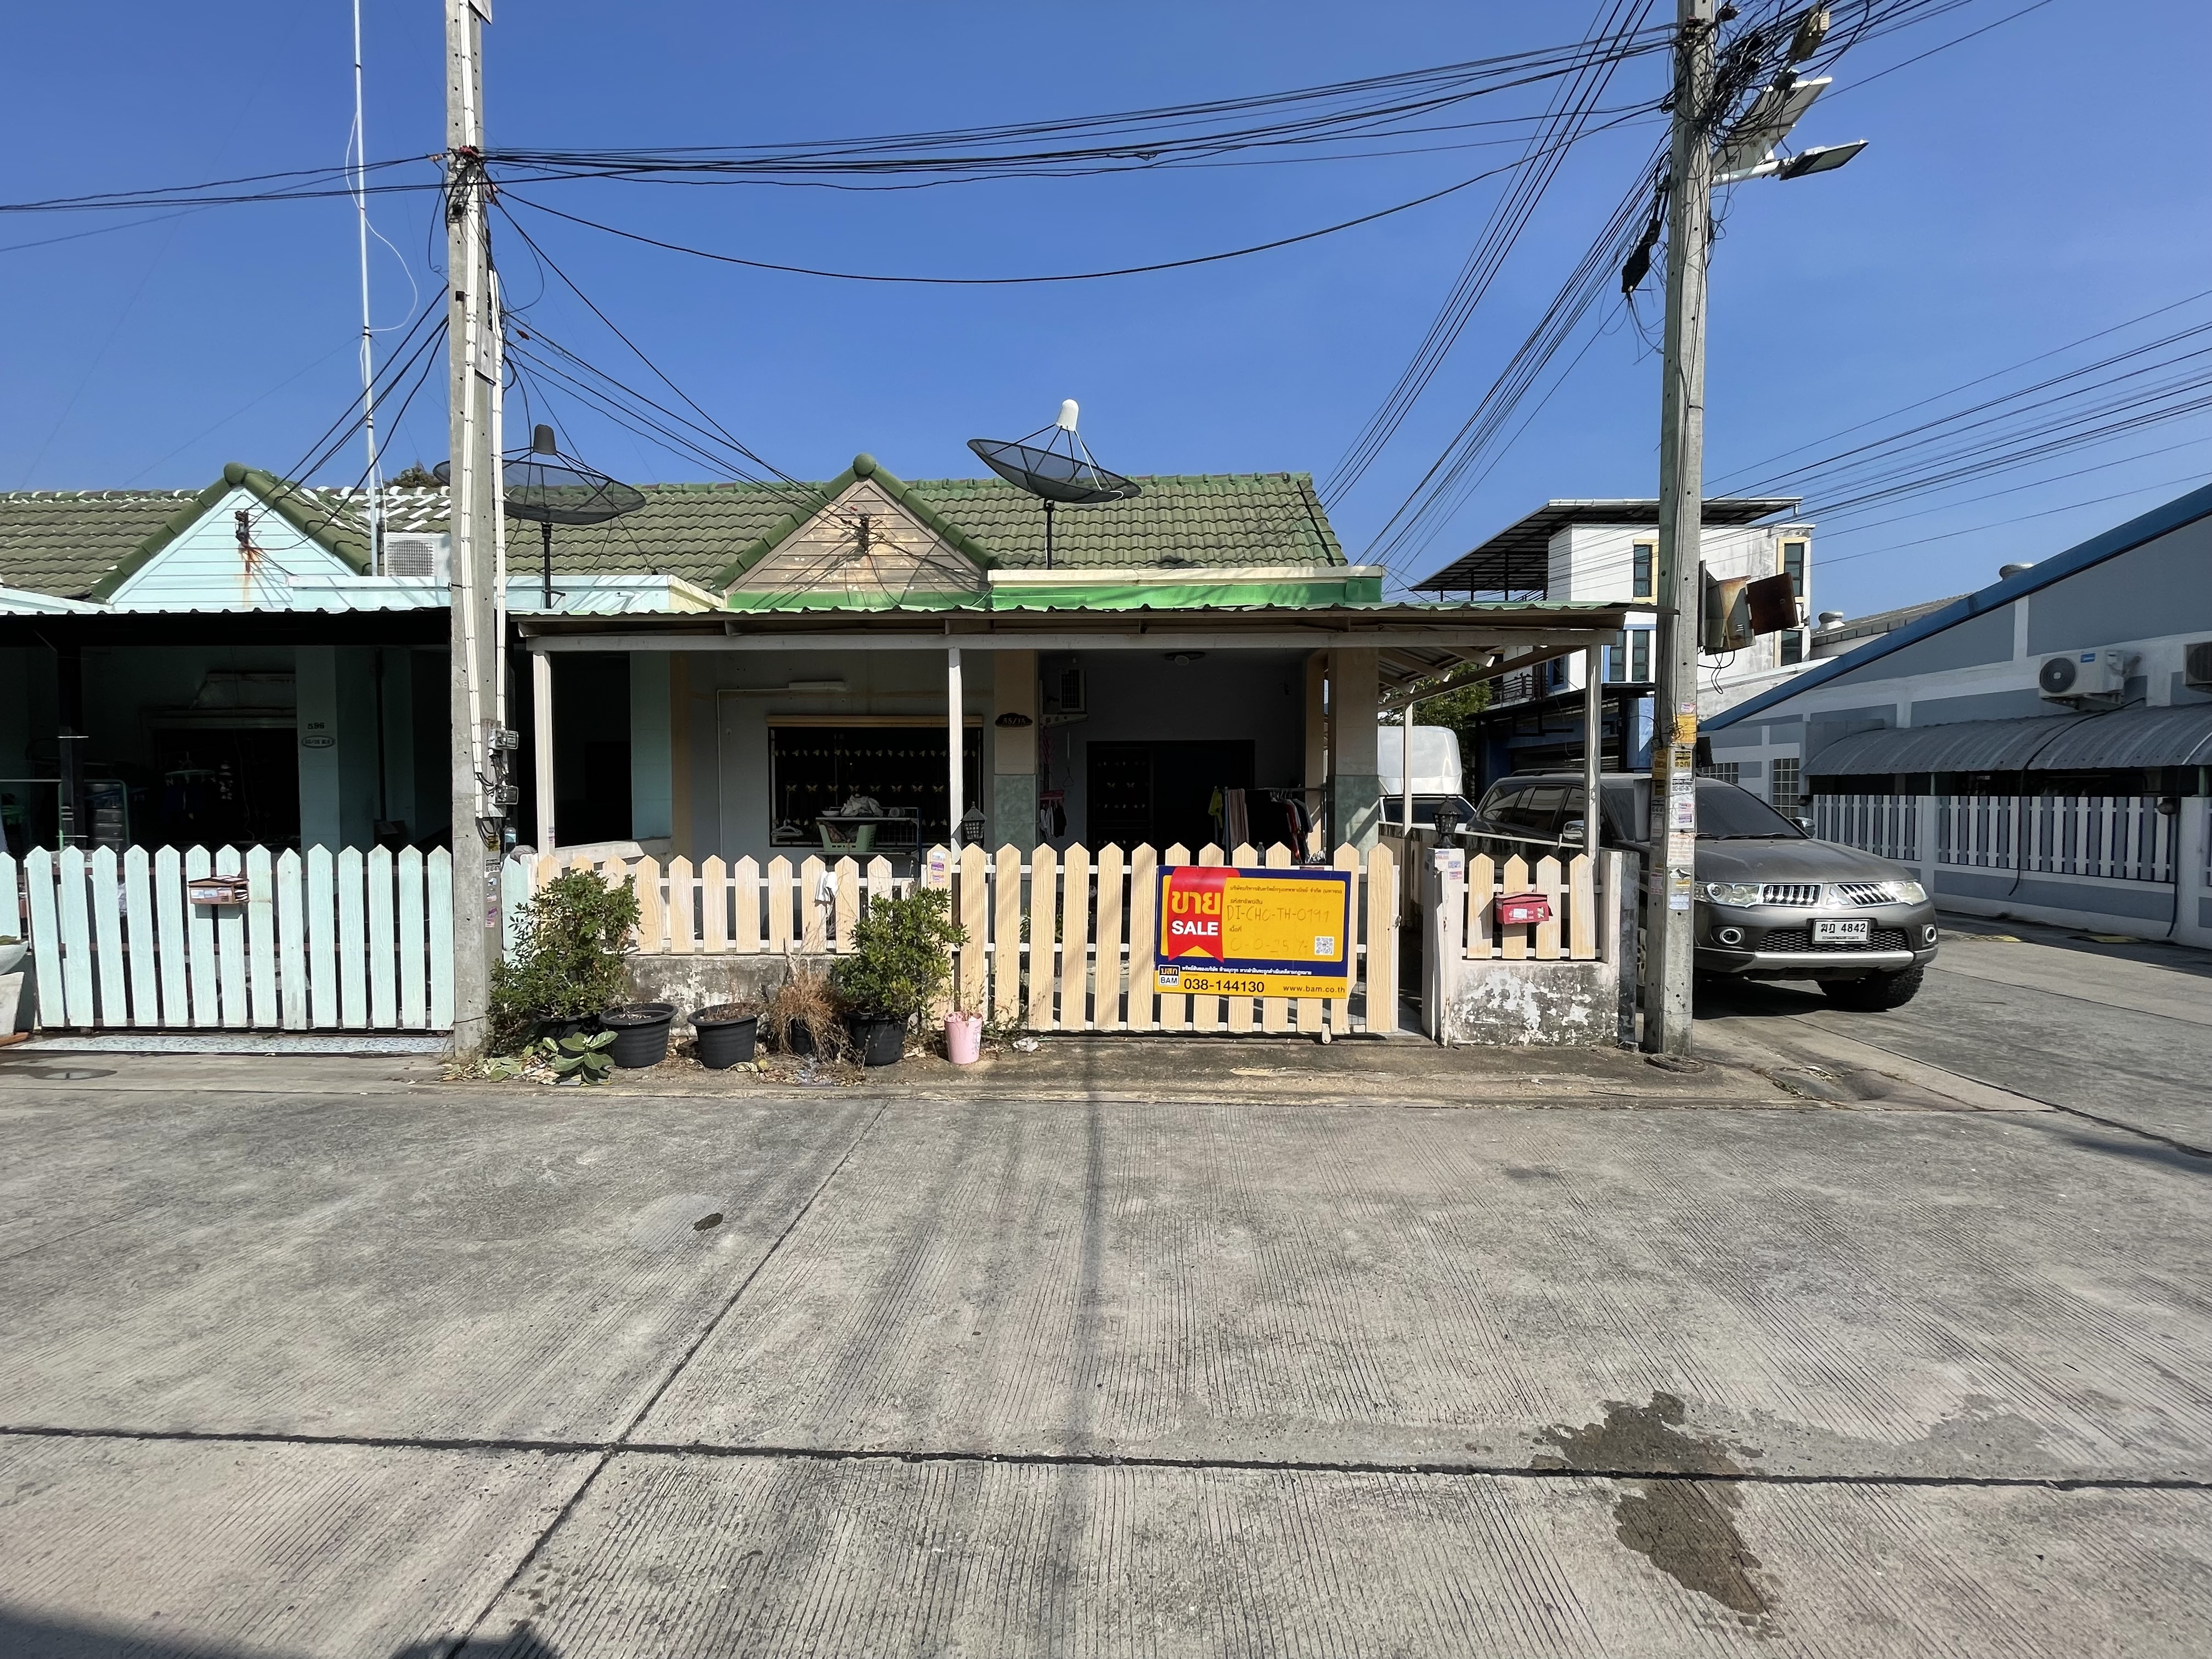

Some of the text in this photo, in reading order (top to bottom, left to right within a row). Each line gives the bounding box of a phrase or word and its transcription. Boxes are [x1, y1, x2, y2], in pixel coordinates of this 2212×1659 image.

[1172, 891, 1221, 915] ขาย
[1171, 920, 1219, 936] SALE
[1841, 923, 1866, 933] 4842
[1184, 978, 1265, 992] 038-144130
